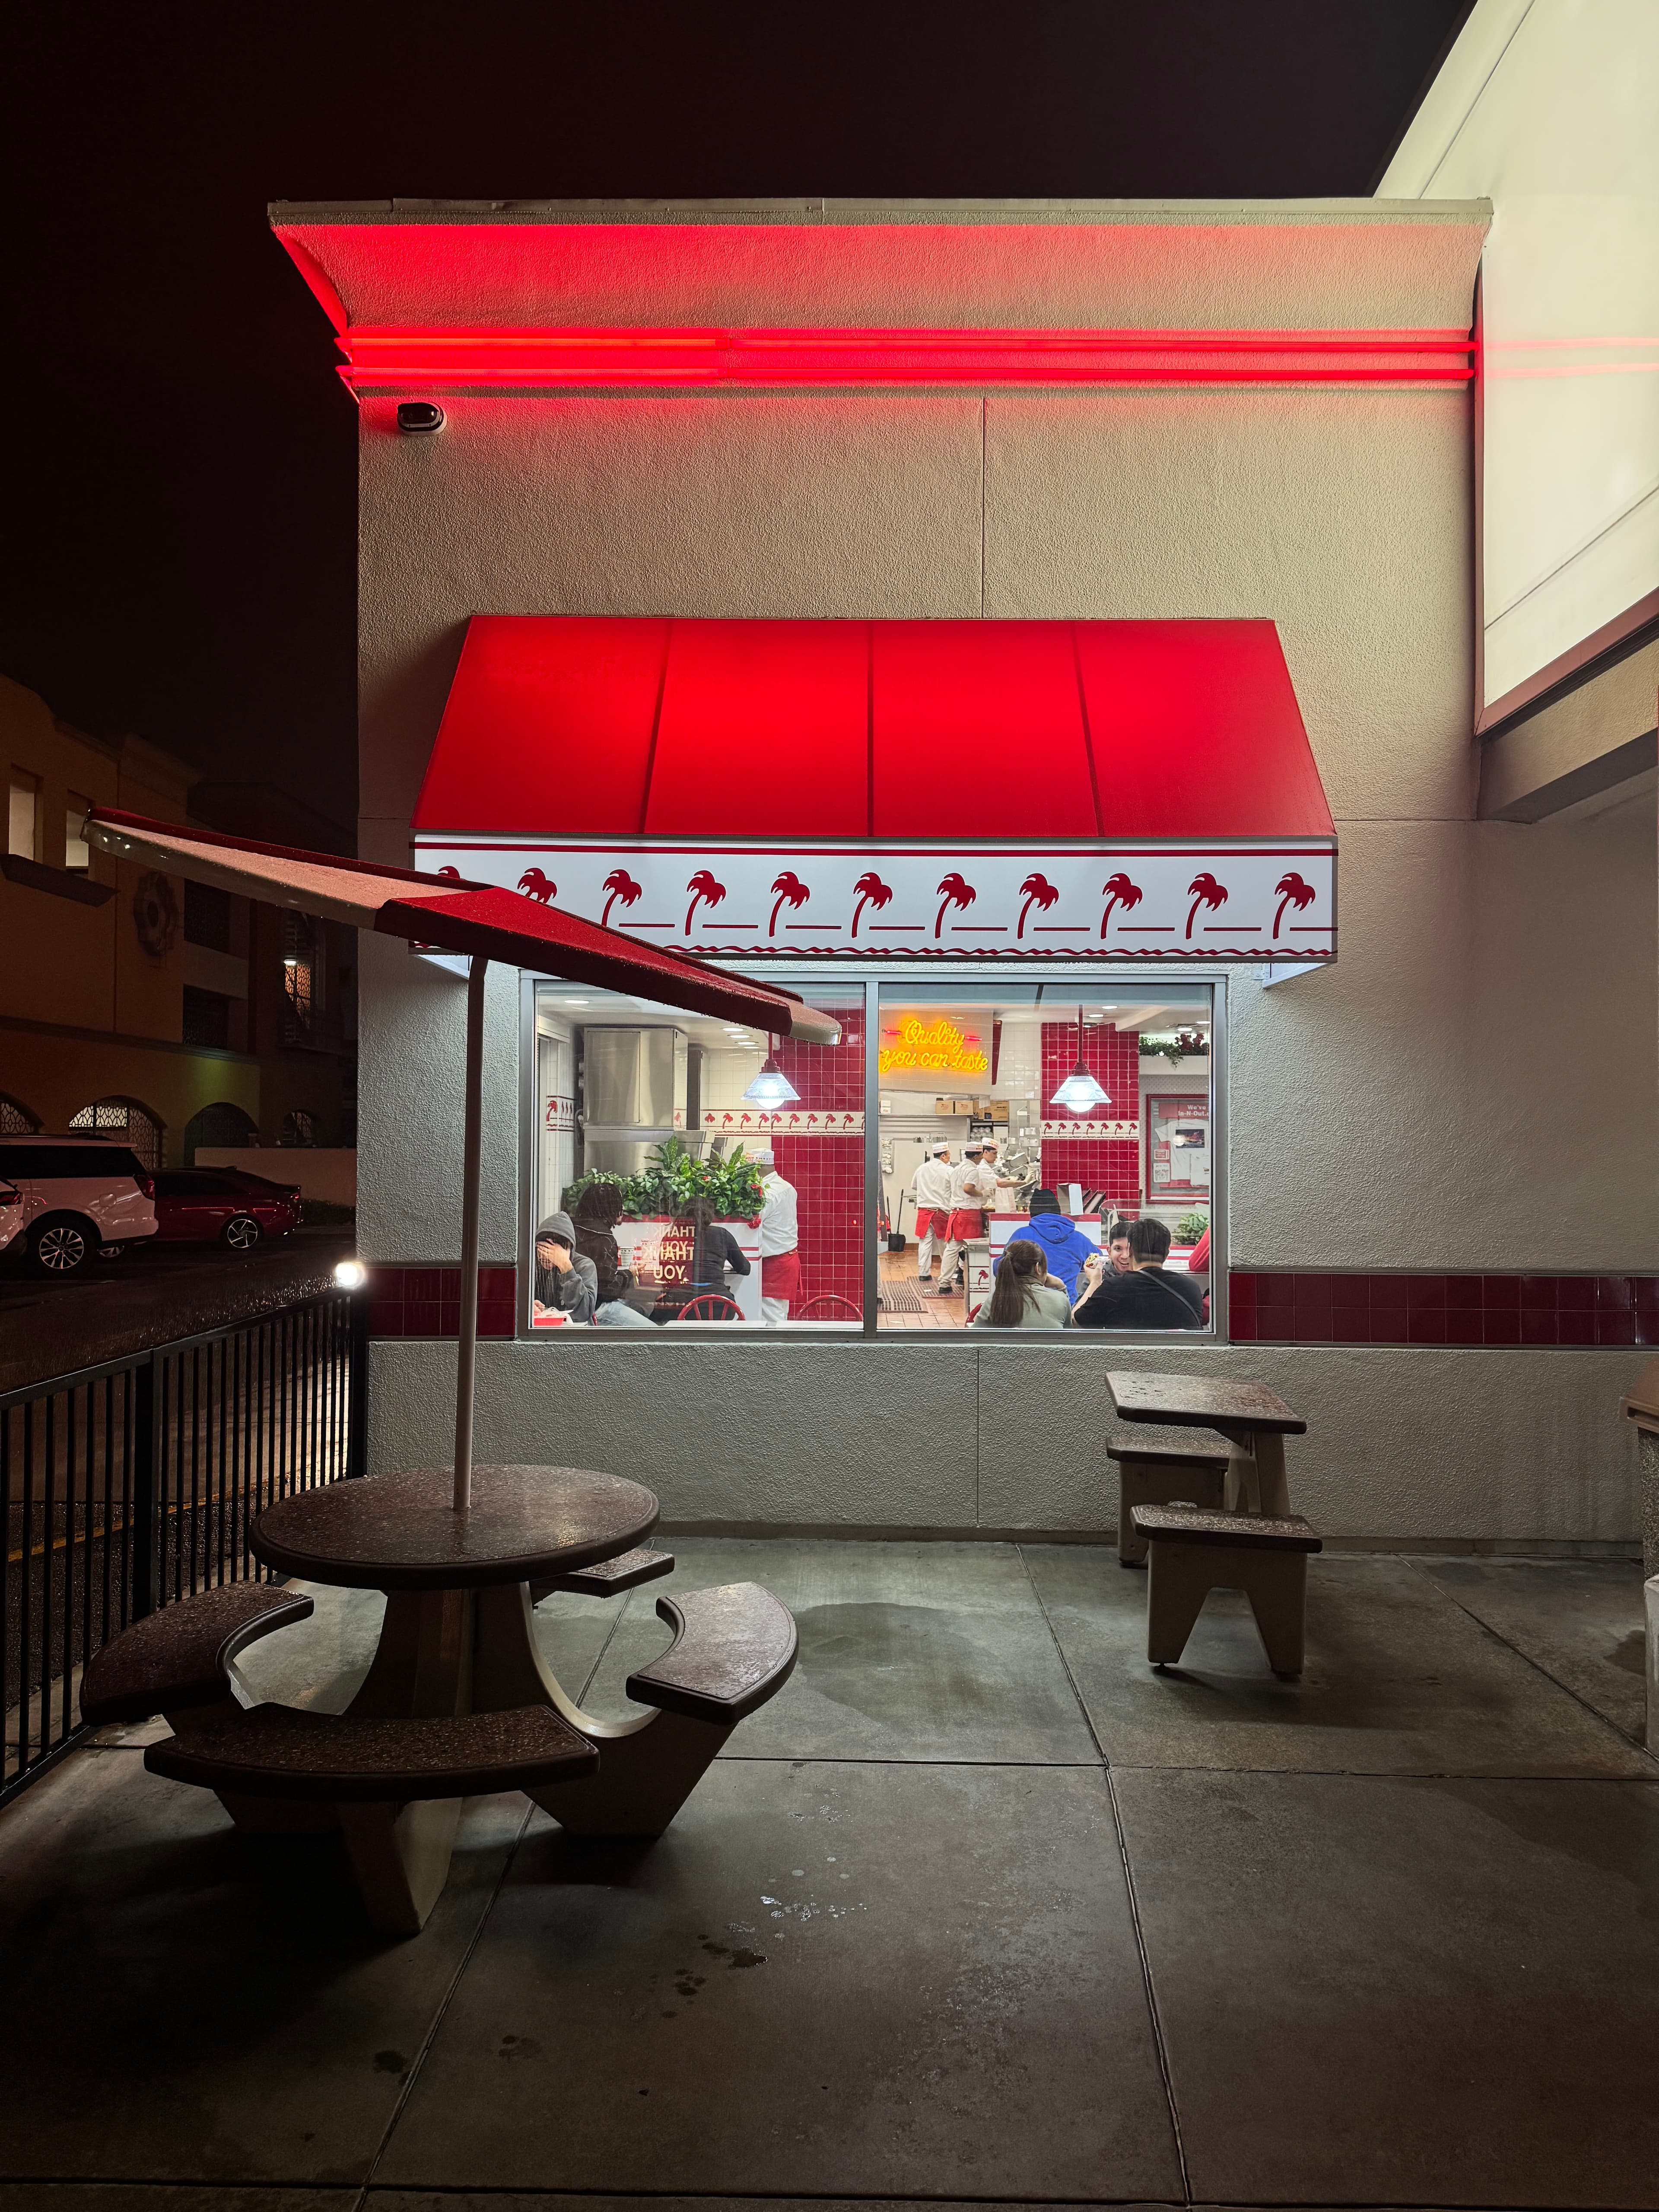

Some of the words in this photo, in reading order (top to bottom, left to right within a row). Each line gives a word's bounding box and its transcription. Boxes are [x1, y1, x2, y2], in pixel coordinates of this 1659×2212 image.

[905, 1020, 965, 1053] Quality
[883, 1050, 917, 1072] you
[921, 1052, 948, 1067] can
[952, 1049, 988, 1071] taste
